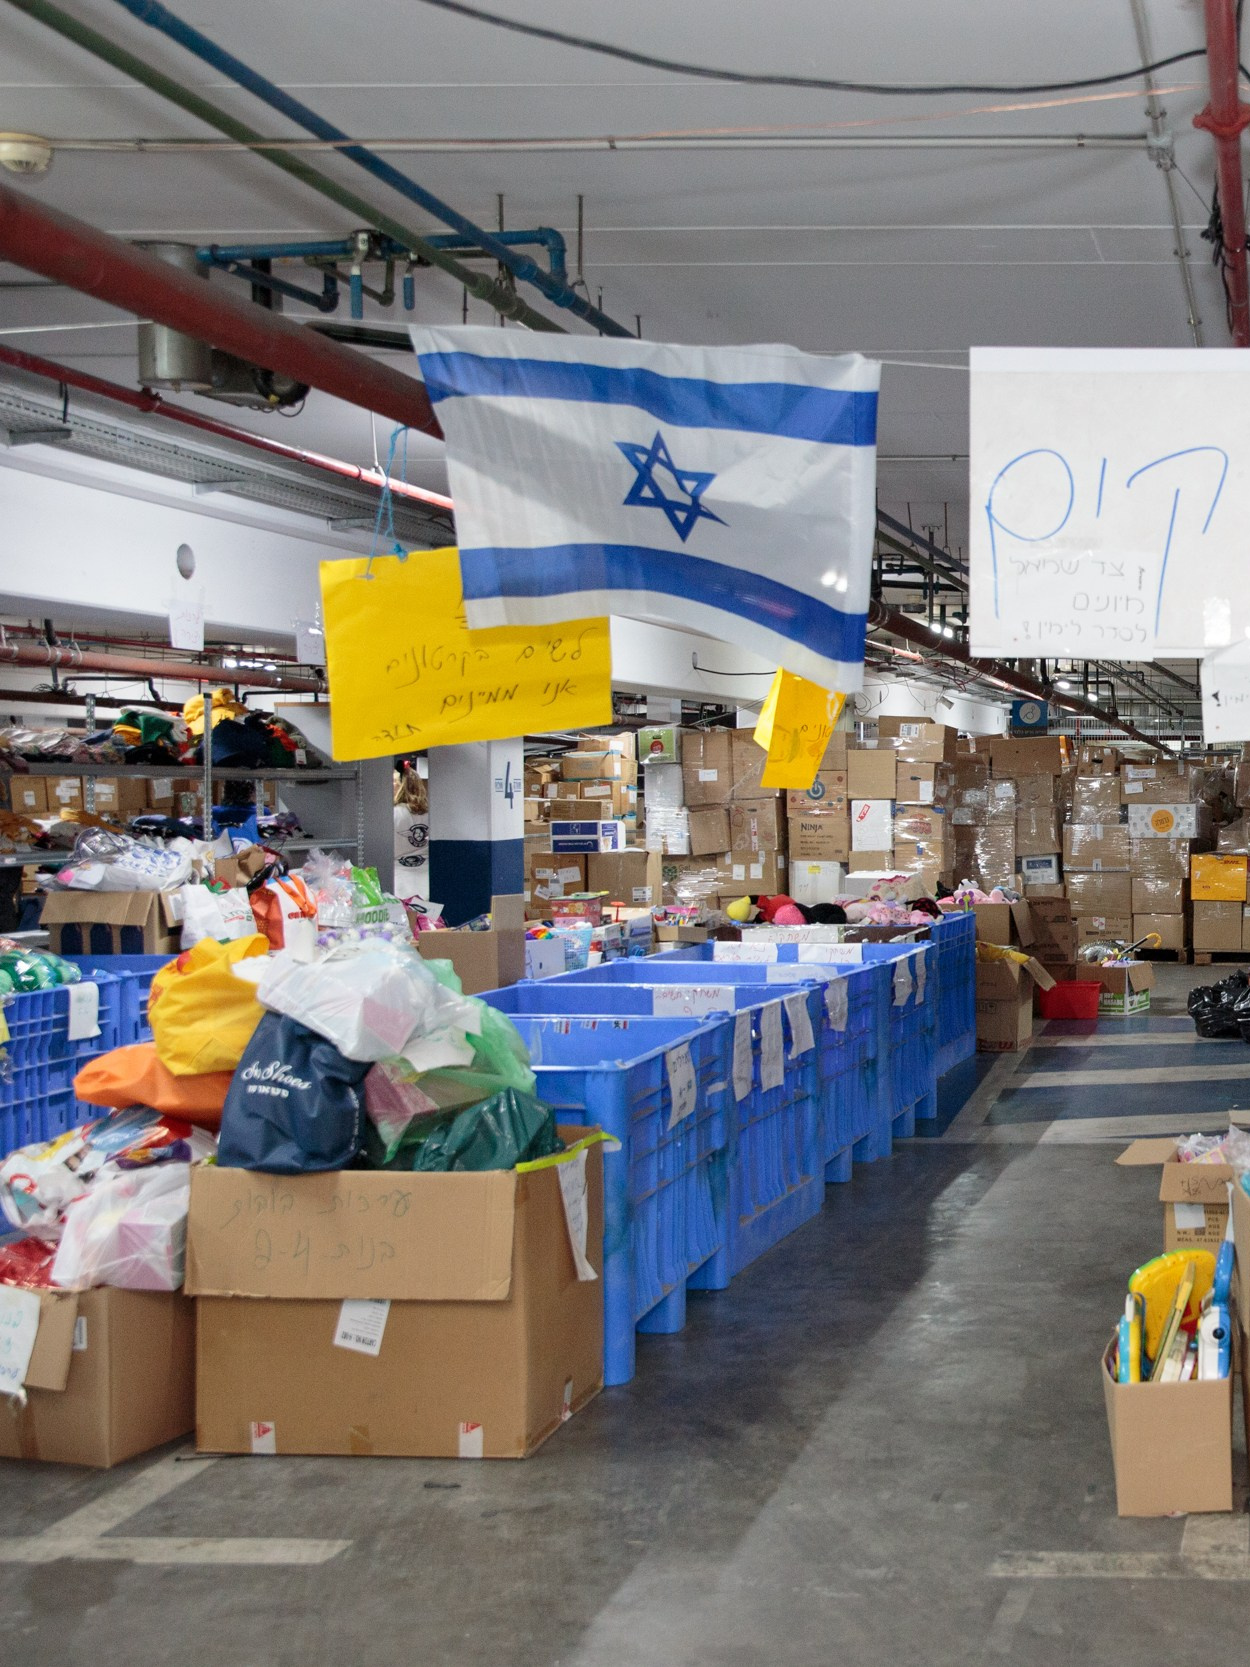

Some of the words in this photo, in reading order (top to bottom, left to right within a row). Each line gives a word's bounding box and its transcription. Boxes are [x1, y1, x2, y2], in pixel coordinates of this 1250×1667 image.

[1009, 556, 1080, 576] שמאל
[1091, 560, 1125, 577] צד
[1092, 623, 1147, 642] לסדר
[515, 627, 598, 664] לשים
[386, 643, 489, 690] בקרטונים
[800, 822, 823, 833] NINJA
